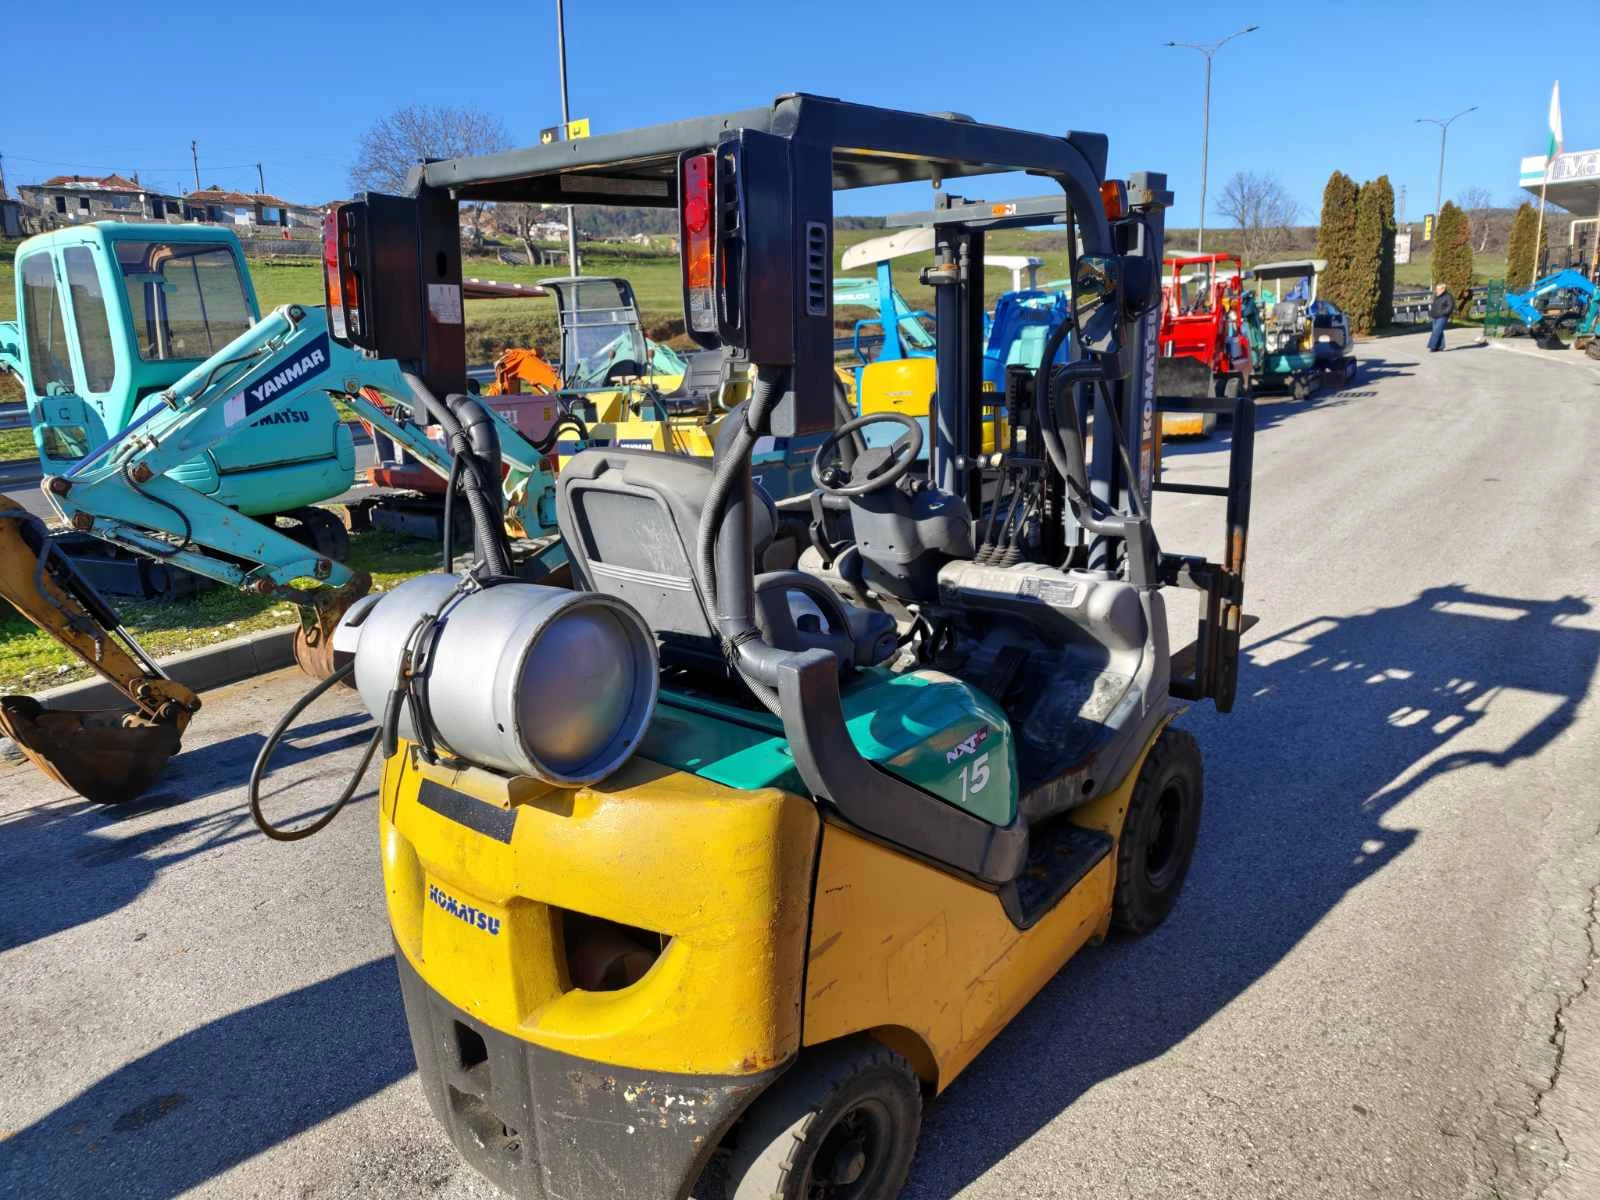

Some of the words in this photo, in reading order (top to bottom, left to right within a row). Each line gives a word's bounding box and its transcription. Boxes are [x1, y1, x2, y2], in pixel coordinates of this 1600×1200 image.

[251, 349, 325, 401] YANMAR
[1142, 310, 1157, 440] KOMATSU
[249, 408, 310, 427] MATSU
[958, 752, 990, 802] 15
[429, 883, 500, 935] KOMATSU
